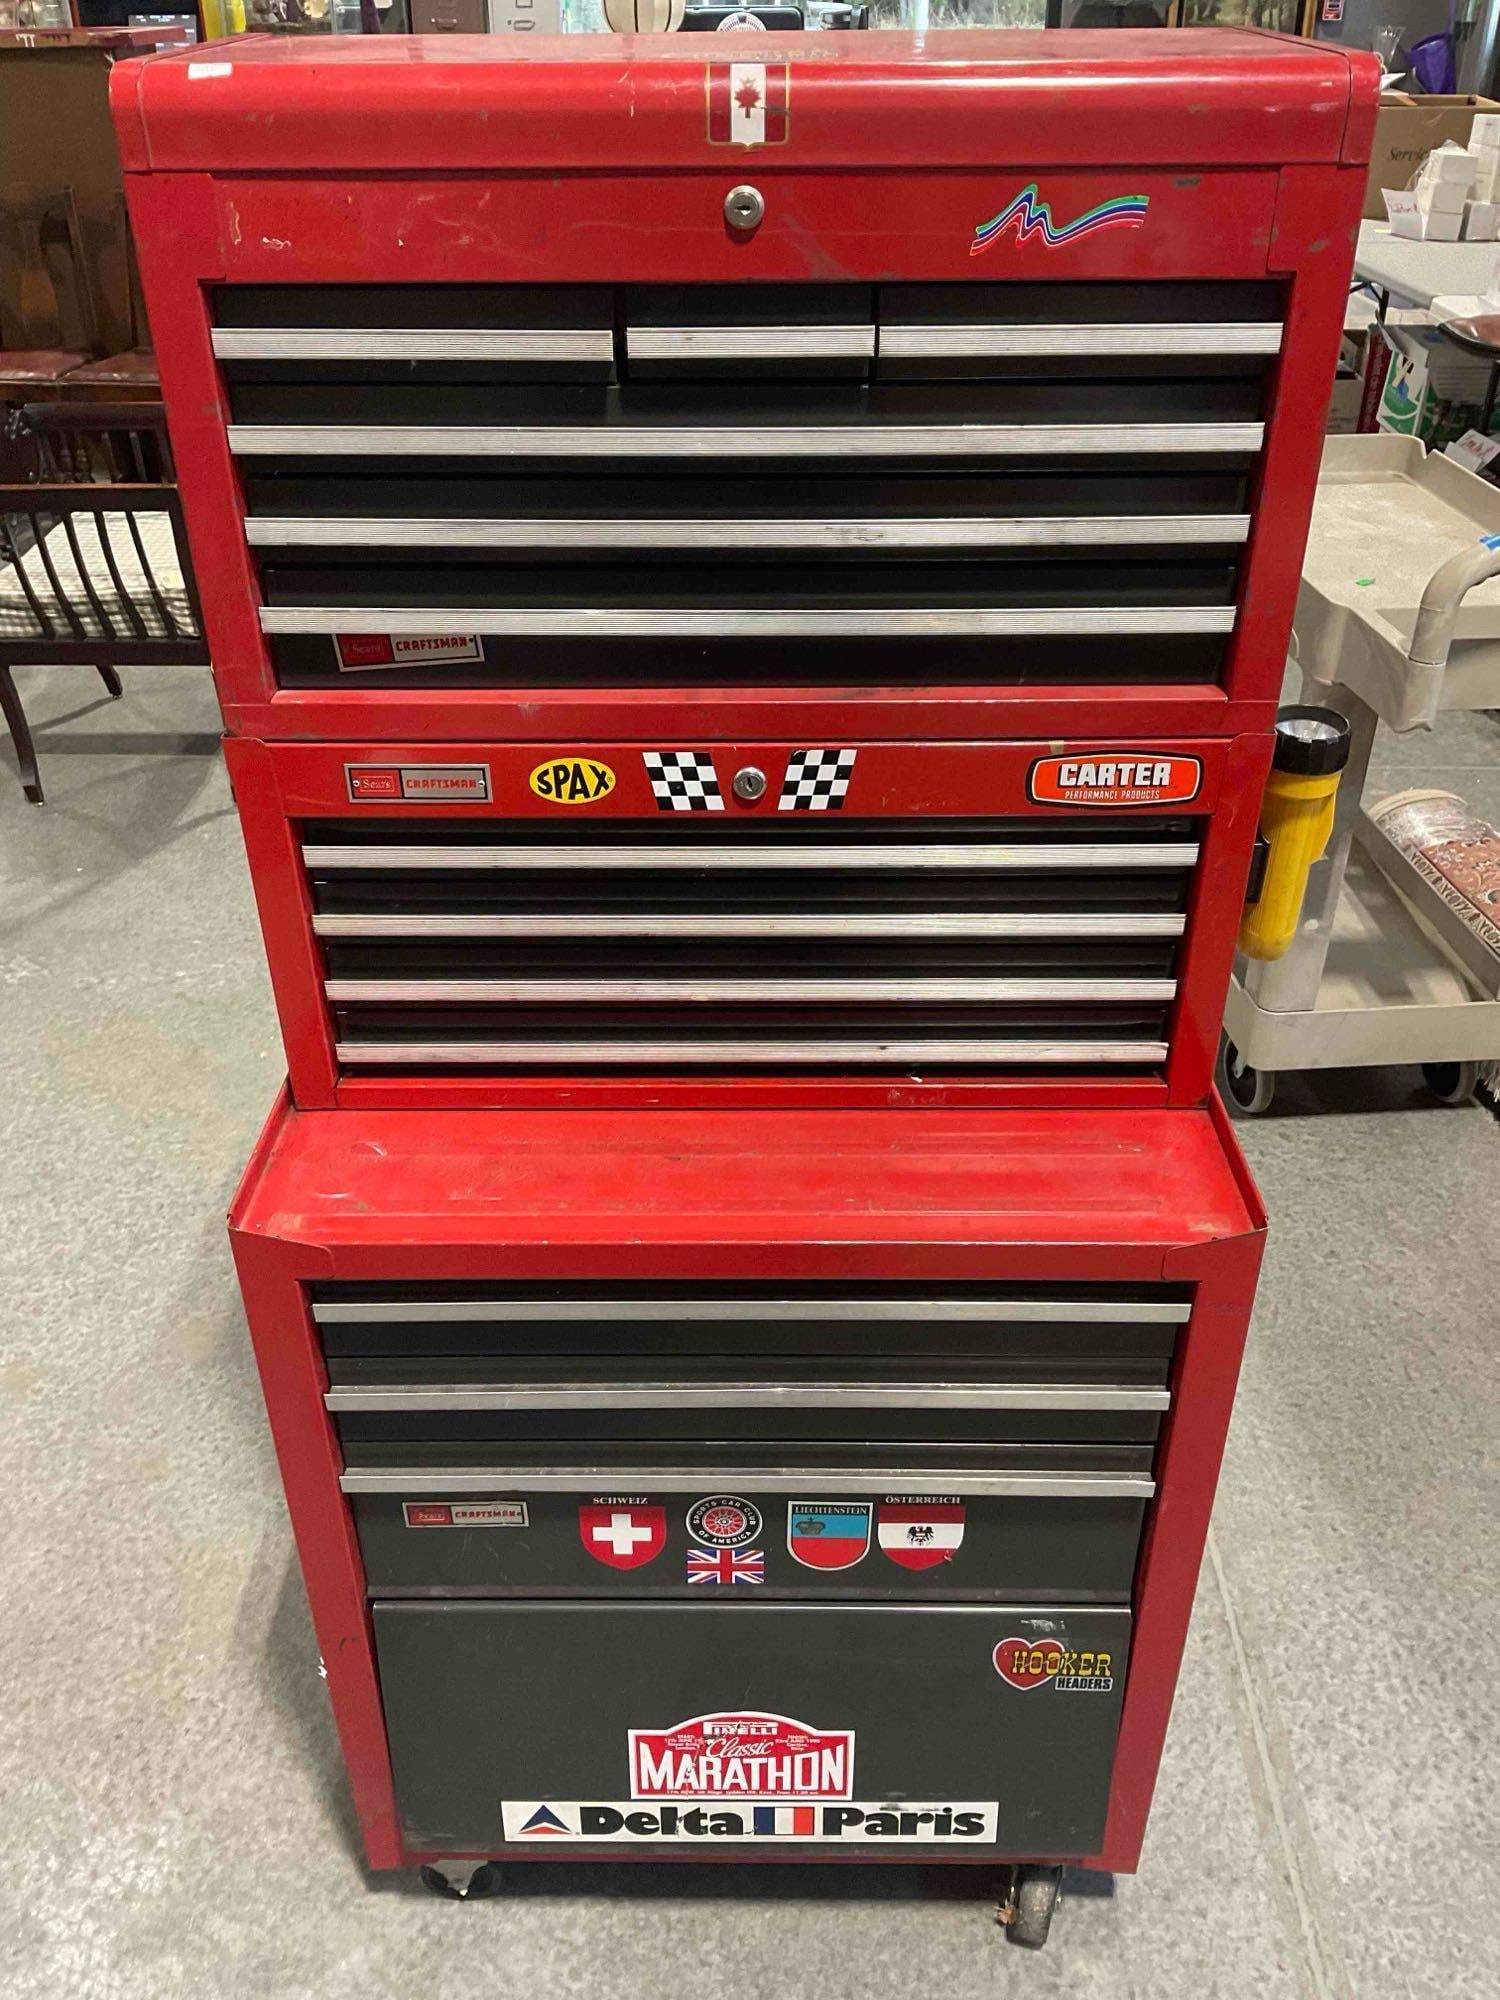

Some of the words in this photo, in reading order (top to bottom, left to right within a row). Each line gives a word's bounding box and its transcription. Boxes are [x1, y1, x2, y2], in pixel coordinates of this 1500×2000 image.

[396, 636, 468, 652] CRAFTSMAN
[1058, 762, 1172, 788] CARTER
[406, 779, 477, 789] CRAFTSMAN
[1065, 789, 1118, 800] PERFORMANCE
[1121, 789, 1160, 800] PRODUCTS
[593, 1496, 649, 1505] SCHWEIZ
[885, 1494, 961, 1504] ÖSTERREICH
[454, 1510, 516, 1519] CRAFTSMAN
[693, 1500, 718, 1525] SPORTS
[722, 1499, 741, 1508] CAR
[743, 1507, 757, 1525] CLUB
[794, 1505, 868, 1515] LIECHTENSTEIN
[698, 1529, 709, 1539] OF
[711, 1530, 752, 1545] AMERICA
[1012, 1650, 1111, 1676] HOOKER
[1057, 1677, 1111, 1690] HEADERS
[703, 1721, 779, 1735] PIRELLI
[706, 1737, 774, 1758] Classic
[639, 1742, 844, 1791] MARATHON
[579, 1806, 744, 1836] Delta
[823, 1807, 986, 1837] Paris
